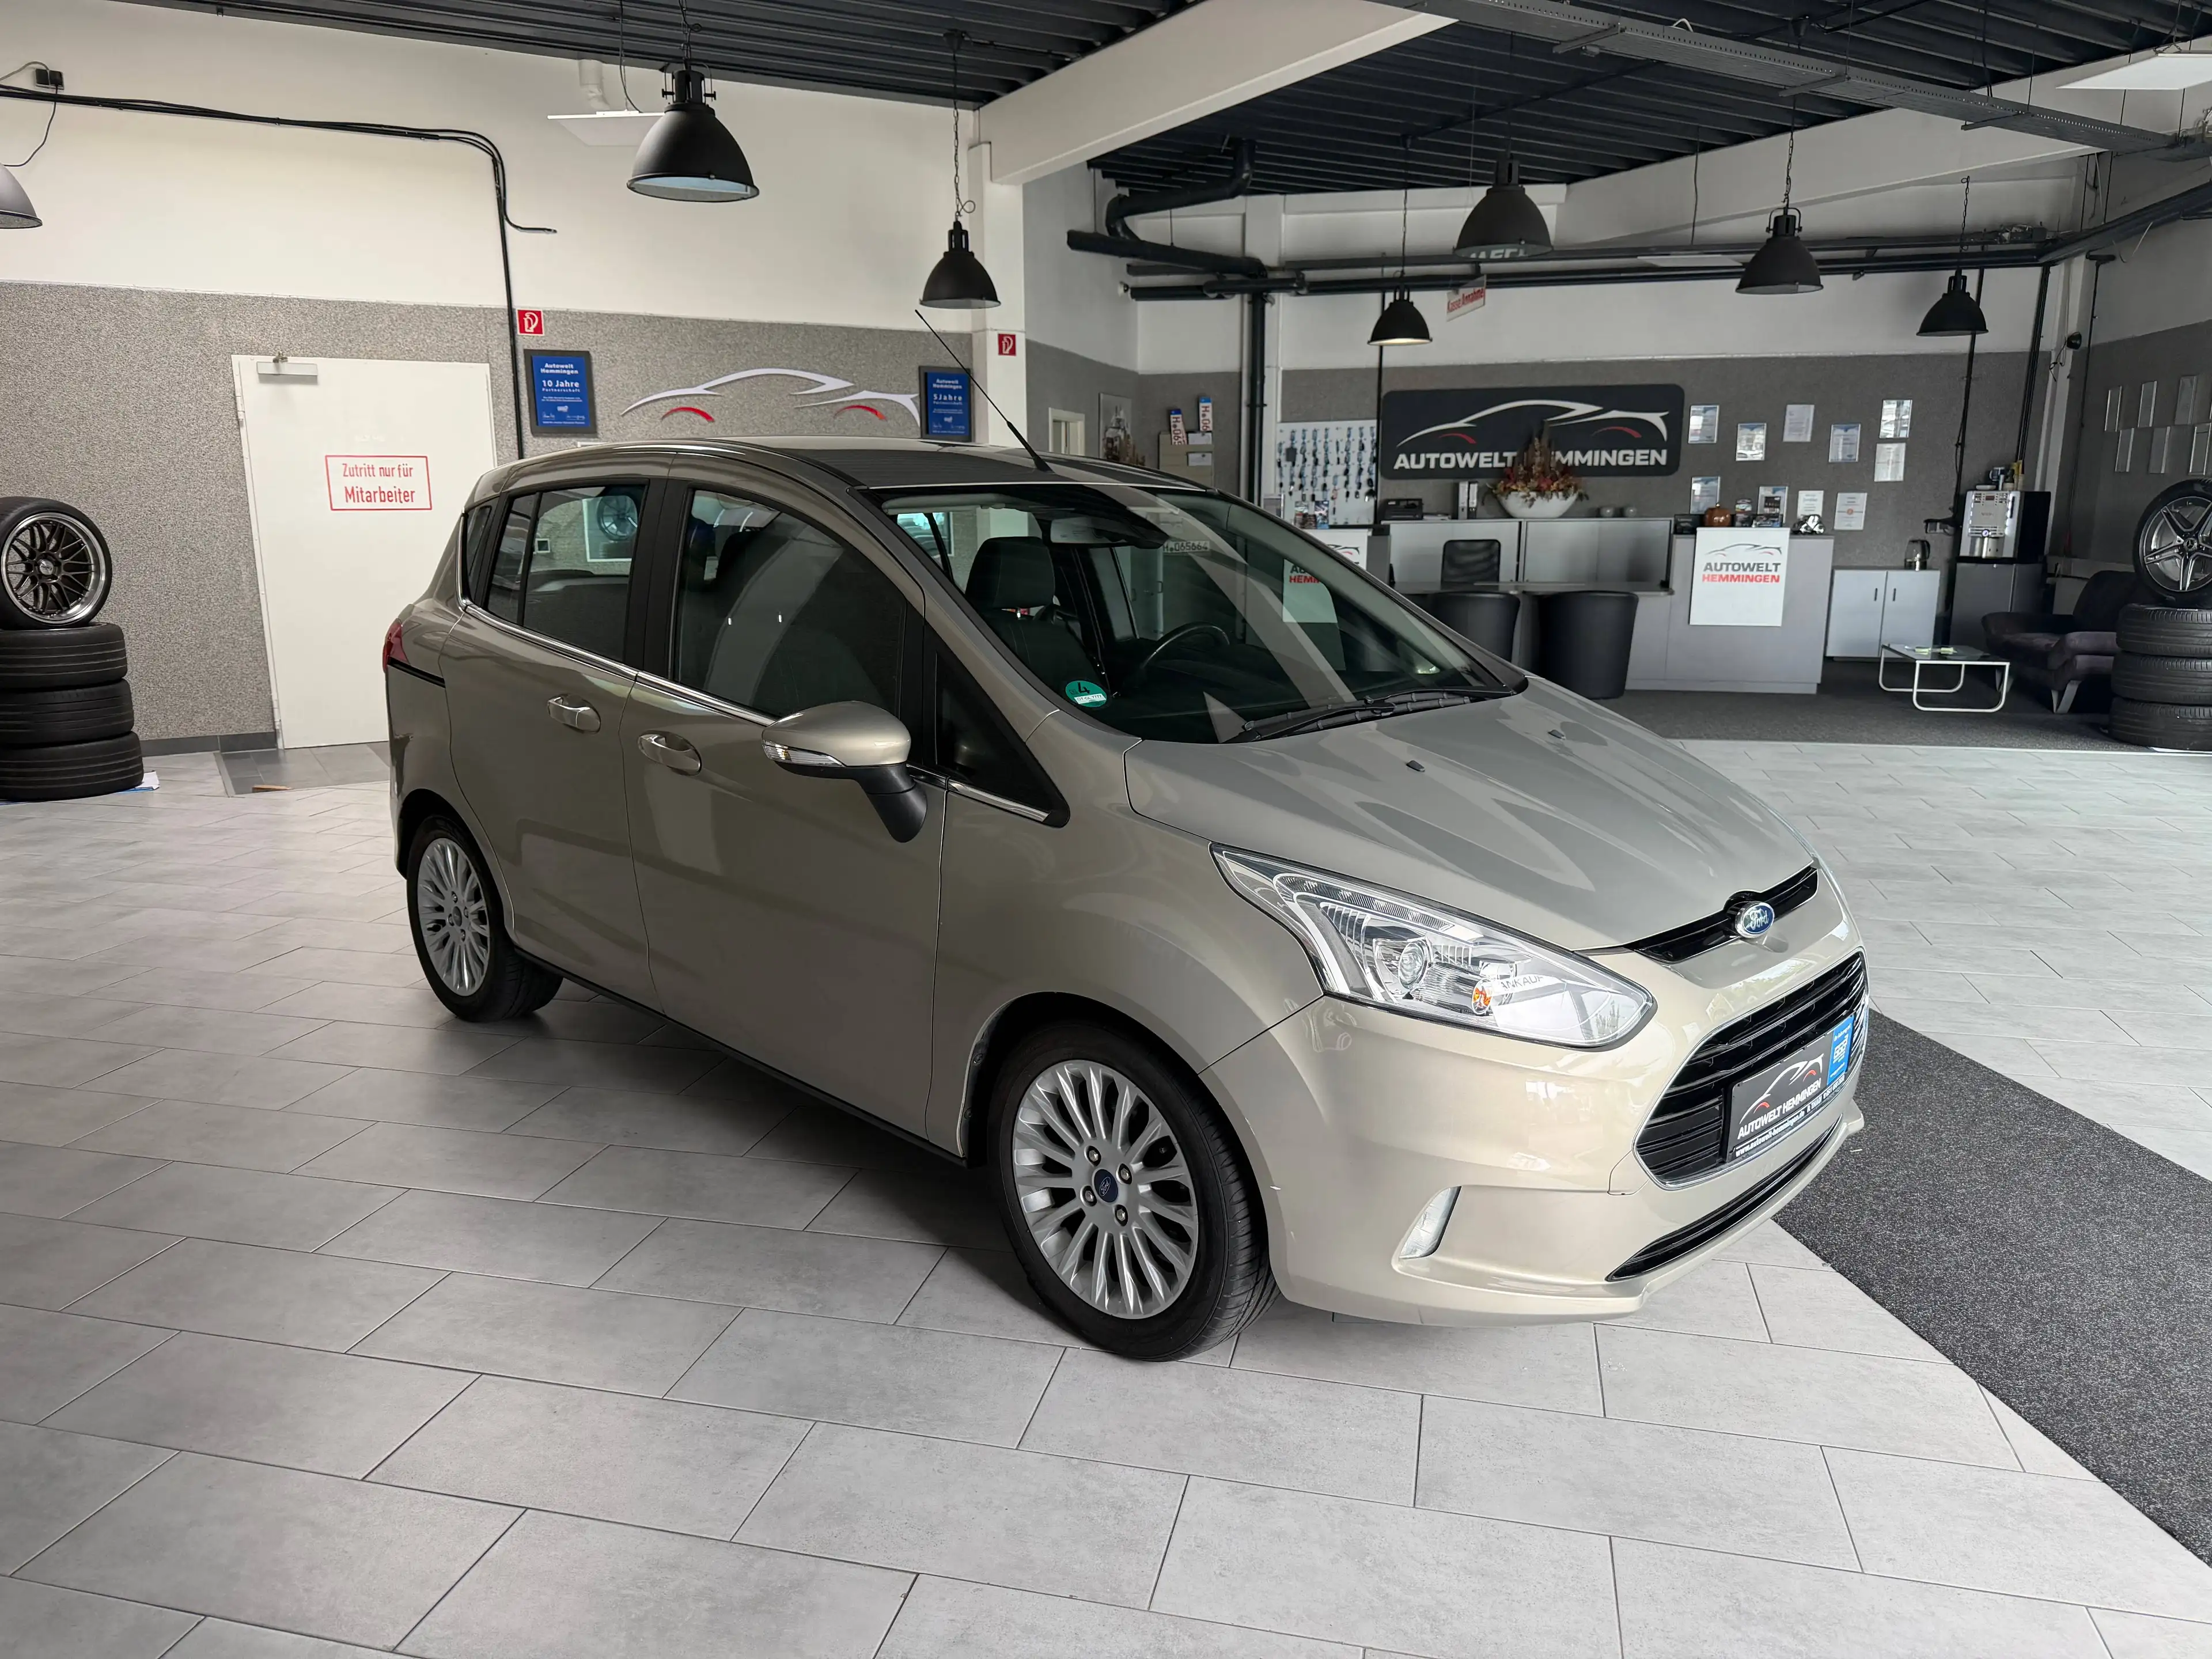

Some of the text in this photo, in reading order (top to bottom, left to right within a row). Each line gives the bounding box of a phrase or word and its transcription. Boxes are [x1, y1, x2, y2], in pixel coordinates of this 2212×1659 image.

[1393, 449, 1667, 470] AUTOWELT MMINGEN
[342, 463, 413, 478] Zutritt nur für
[344, 486, 415, 503] Mitarbeiter
[1703, 562, 1781, 573] AUTOWELT
[1702, 574, 1780, 583] HEMMINGEN
[1077, 682, 1090, 694] 4
[1745, 908, 1770, 930] Ford
[1737, 1105, 1782, 1140] AUTOWELT
[1782, 1077, 1821, 1114] HEMMINGEN
[1100, 1179, 1109, 1195] Ford
